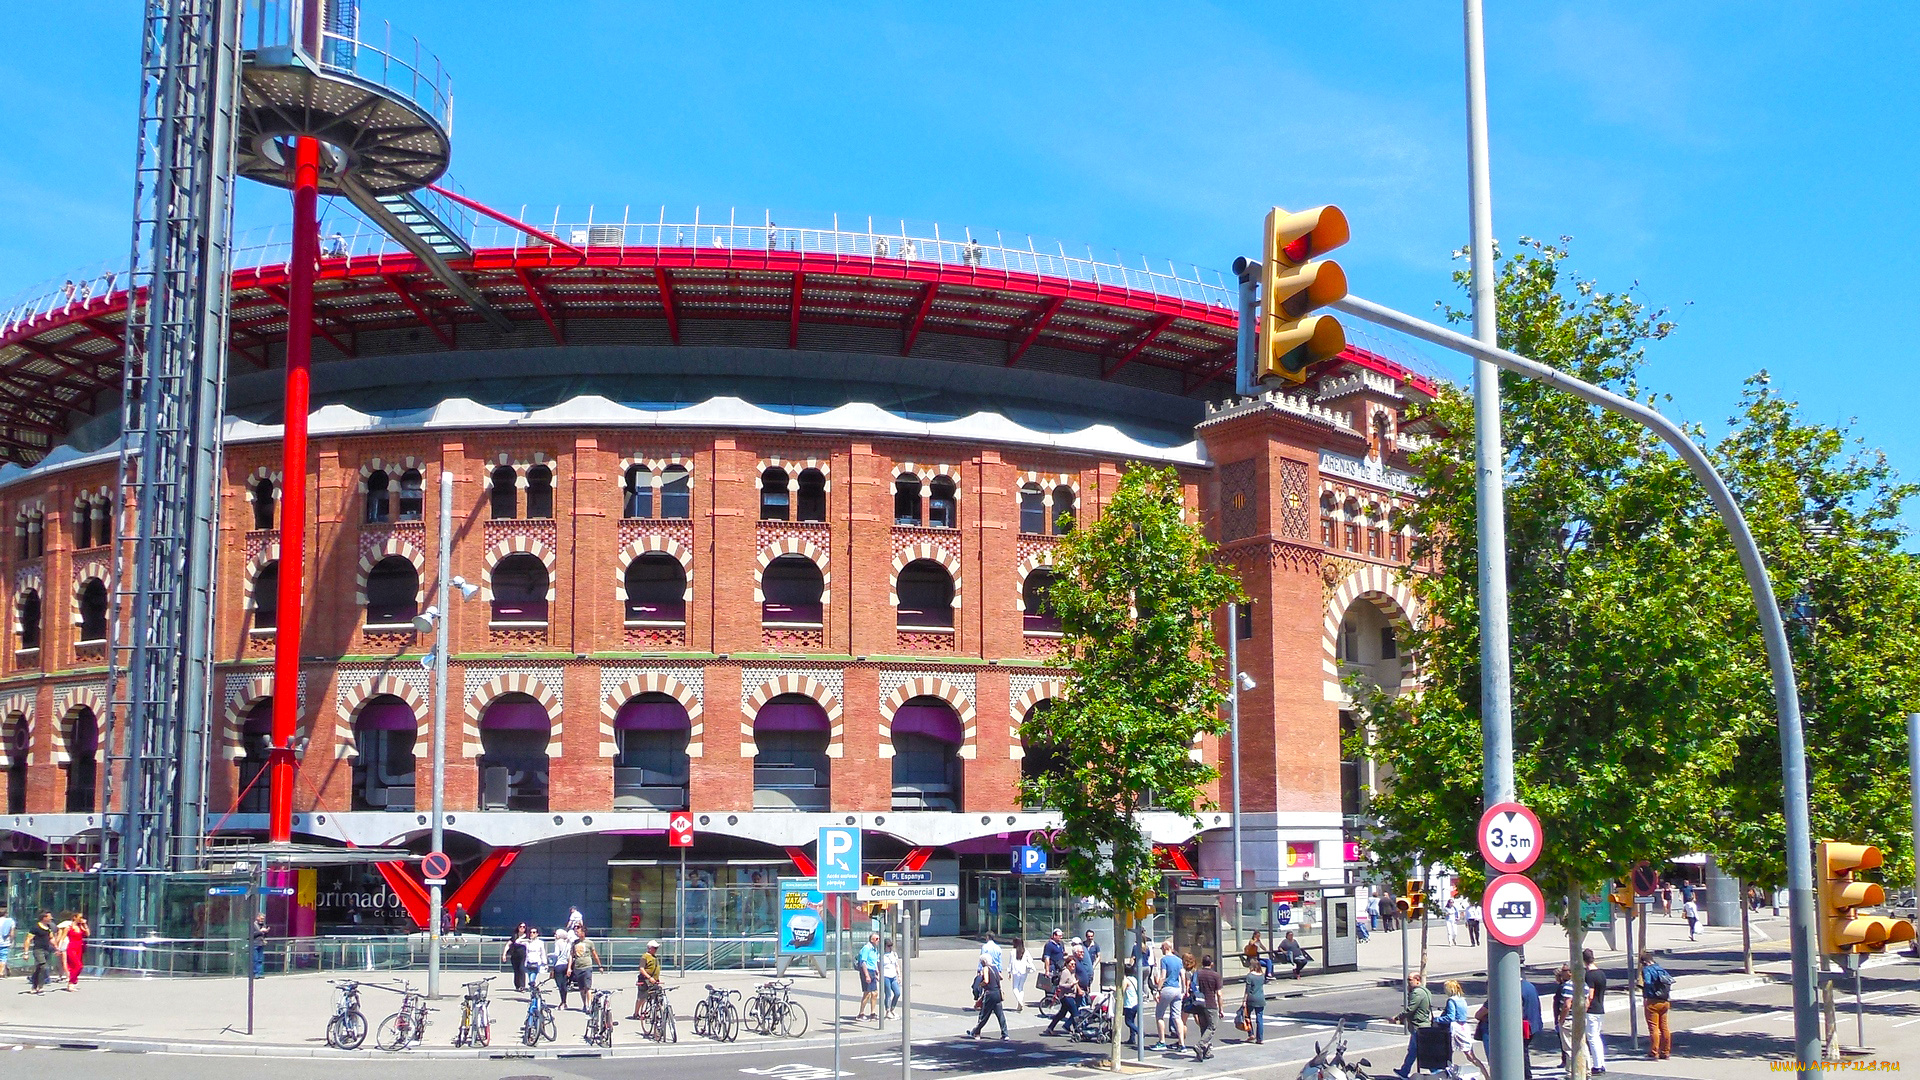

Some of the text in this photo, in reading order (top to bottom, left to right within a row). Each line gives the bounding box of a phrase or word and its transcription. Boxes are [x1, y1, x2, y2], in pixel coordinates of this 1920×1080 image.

[1322, 454, 1356, 476] ARENAS
[676, 820, 685, 828] M
[826, 830, 853, 865] P
[1025, 849, 1039, 868] P
[901, 873, 925, 881] Espanya
[870, 888, 896, 897] Centre
[897, 887, 935, 897] Comercial
[1278, 909, 1291, 920] H12
